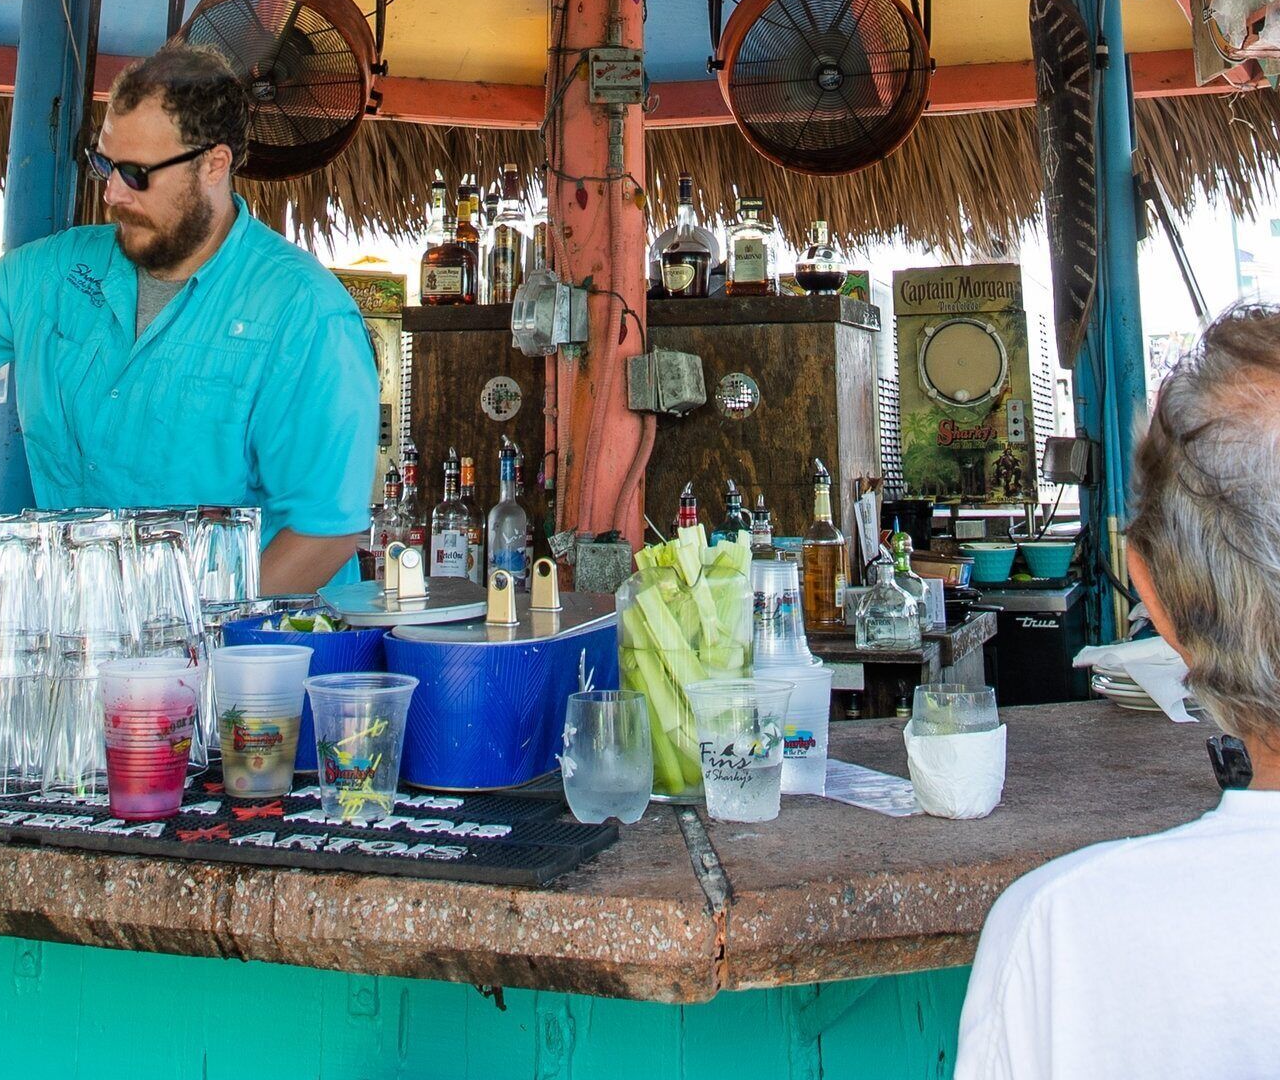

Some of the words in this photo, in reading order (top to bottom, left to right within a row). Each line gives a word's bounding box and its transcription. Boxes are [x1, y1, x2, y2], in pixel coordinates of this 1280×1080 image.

[900, 277, 954, 306] Captain
[954, 275, 1015, 302] Morgan
[937, 419, 998, 446] Sharky's
[436, 549, 453, 564] Ketel
[453, 551, 463, 560] One
[699, 741, 752, 769] Fins
[784, 735, 816, 752] harky's
[712, 769, 753, 789] Sharky's
[228, 828, 470, 861] ARTOIS
